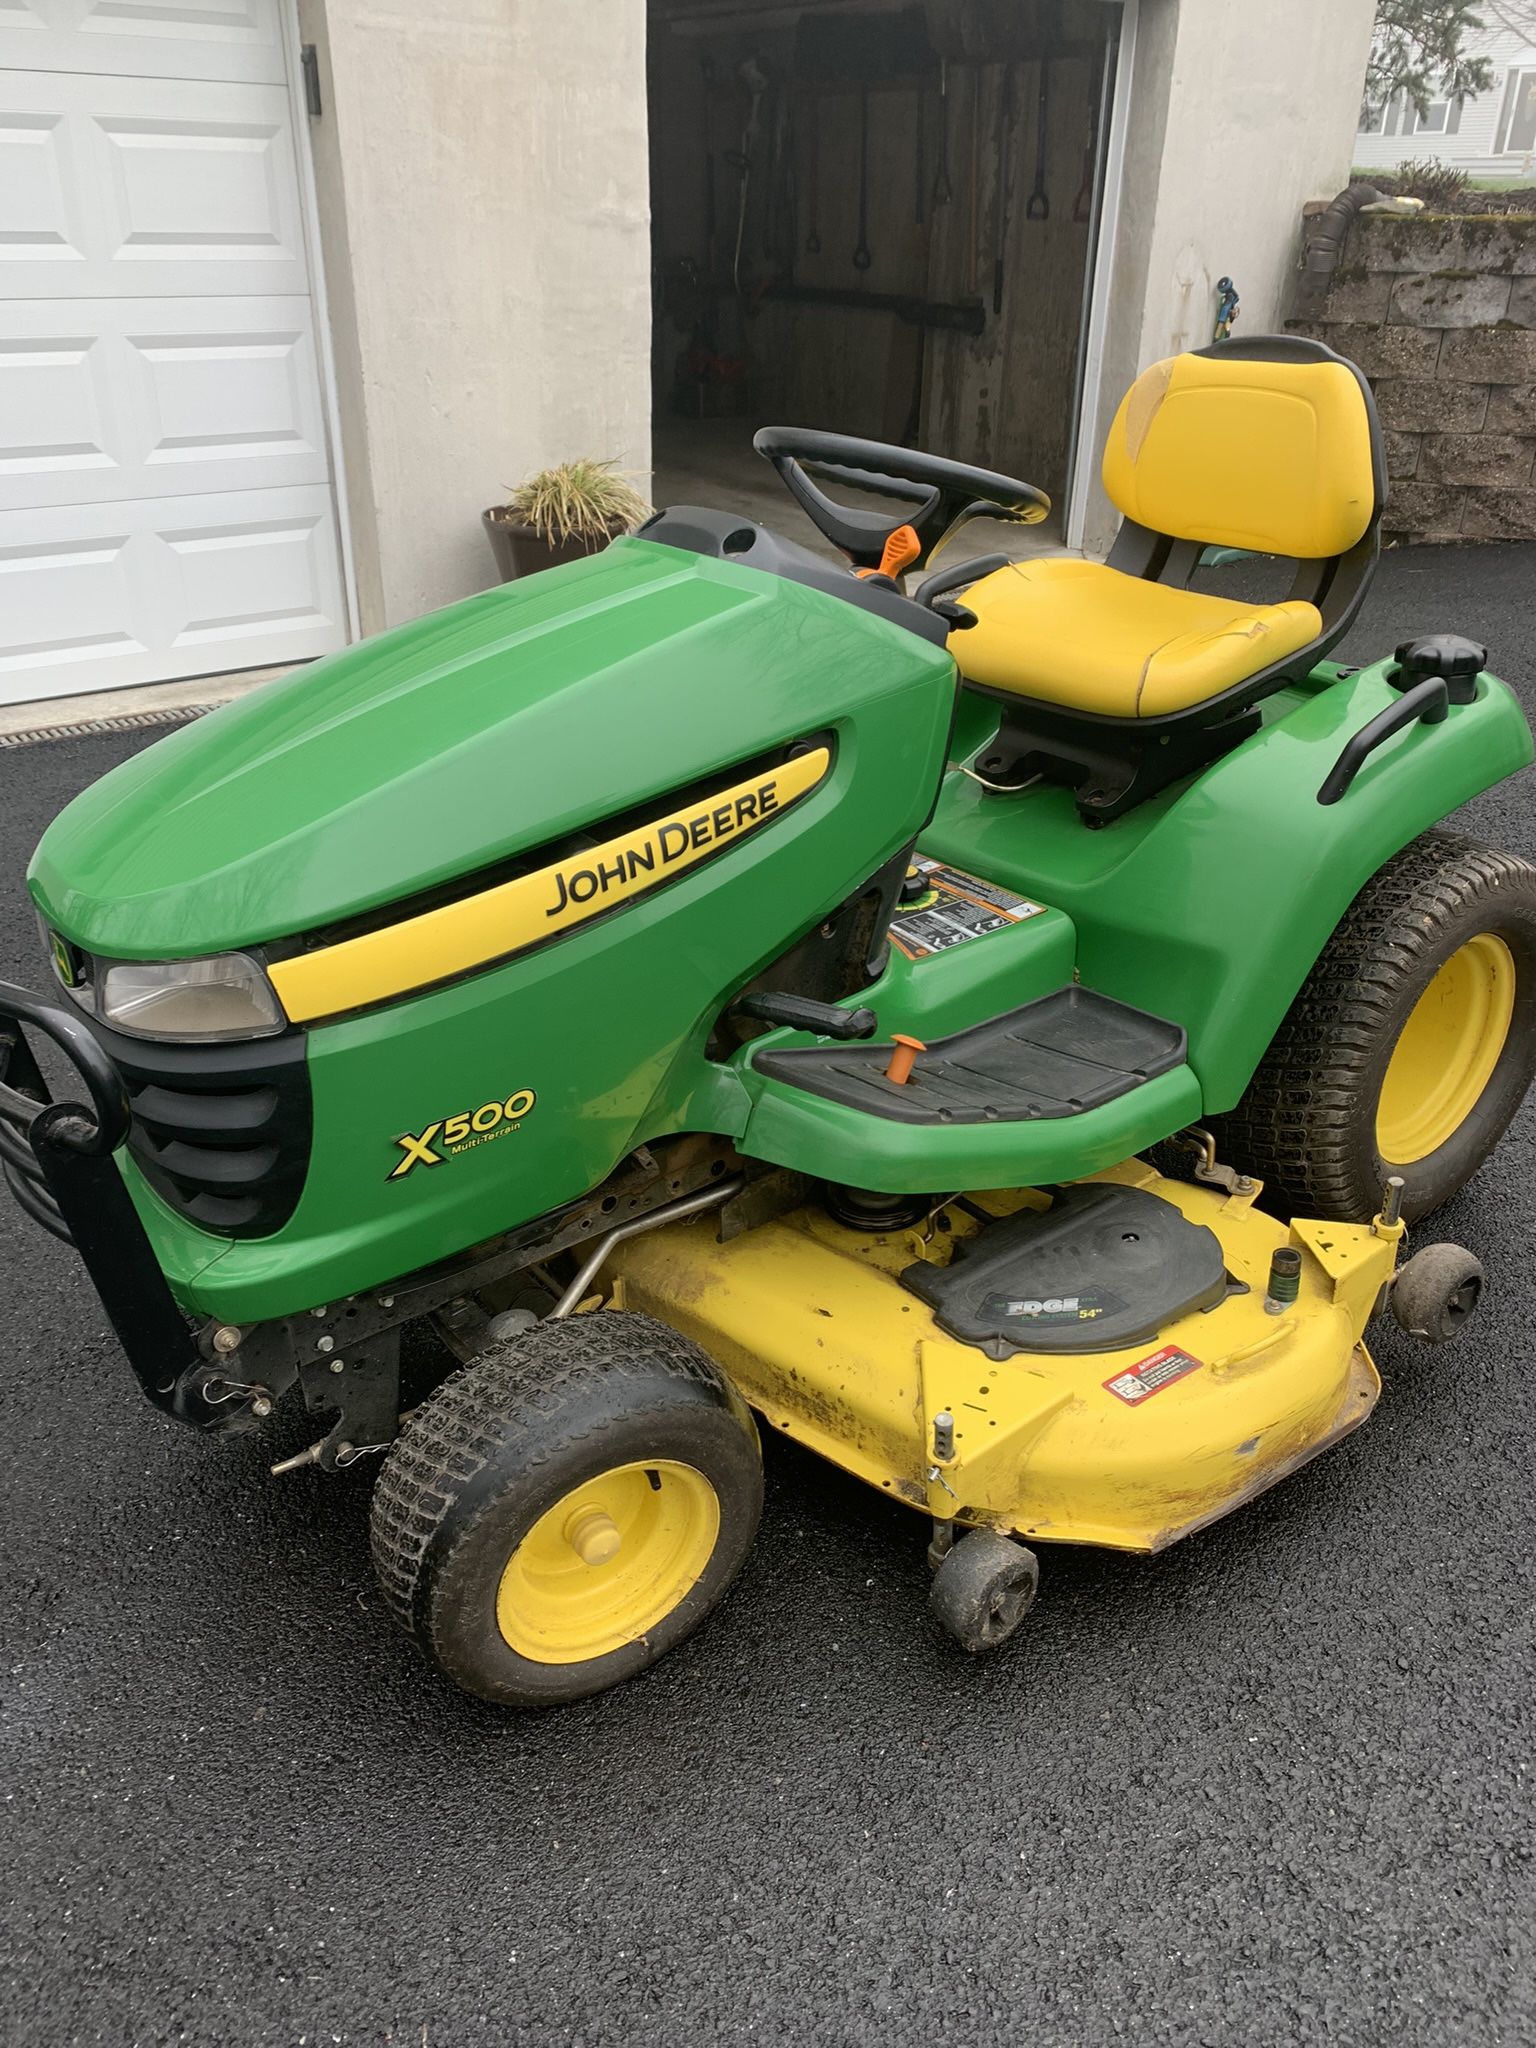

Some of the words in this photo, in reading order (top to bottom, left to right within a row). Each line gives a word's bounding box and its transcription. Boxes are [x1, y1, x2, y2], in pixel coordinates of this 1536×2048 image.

[546, 841, 655, 917] JOHN
[657, 780, 779, 864] DEERE
[385, 1087, 537, 1181] X500
[451, 1121, 521, 1155] Multi-Terrain
[1005, 1298, 1079, 1316] EDGE
[1079, 1308, 1103, 1319] 54"
